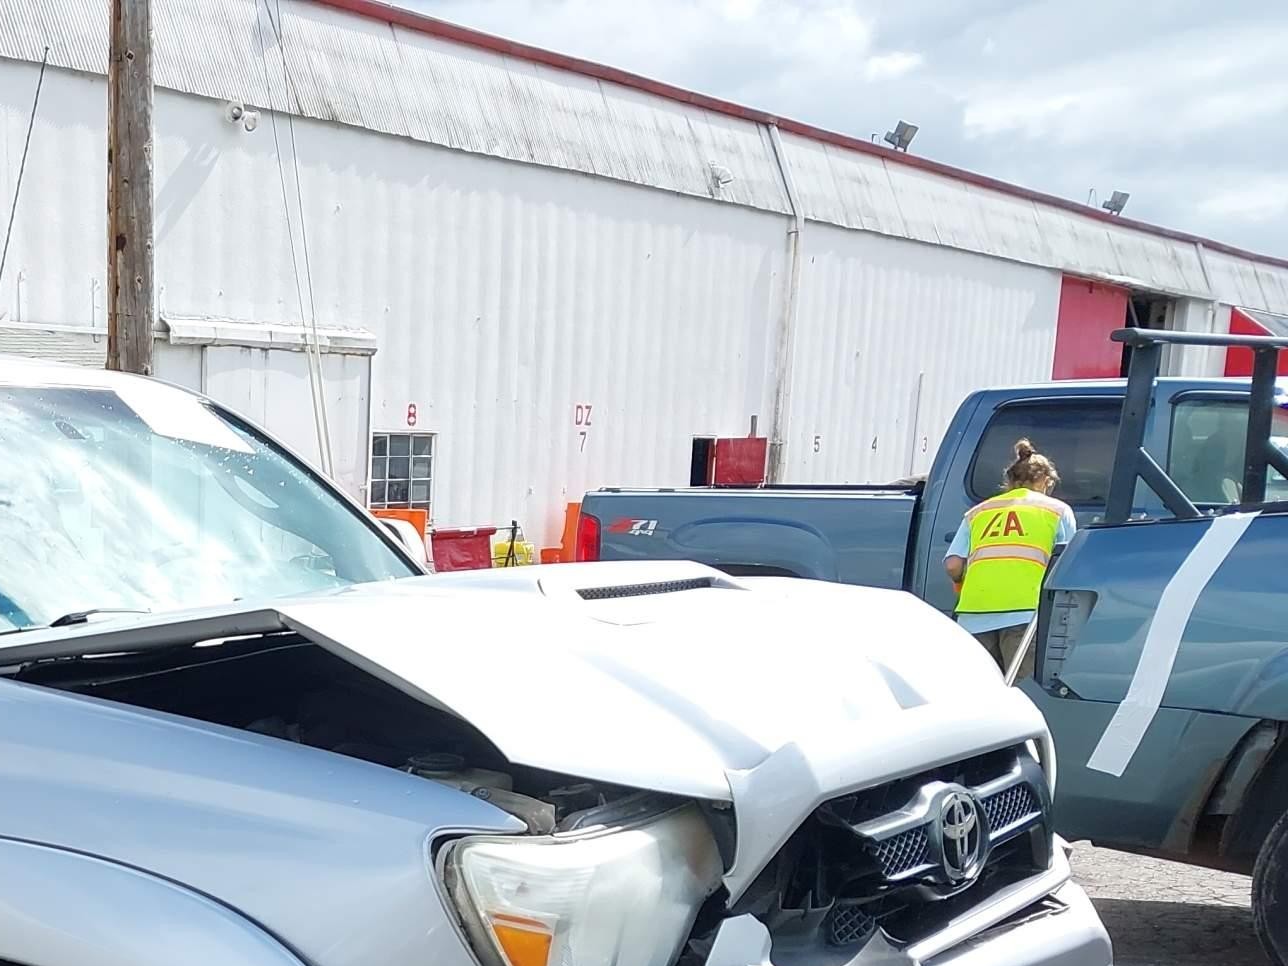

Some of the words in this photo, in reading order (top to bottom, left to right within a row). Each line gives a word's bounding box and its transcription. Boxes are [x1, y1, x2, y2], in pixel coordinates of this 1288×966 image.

[407, 403, 416, 426] 8
[579, 432, 586, 452] 7
[814, 436, 821, 452] 5
[871, 437, 878, 452] 4
[922, 437, 928, 452] 3
